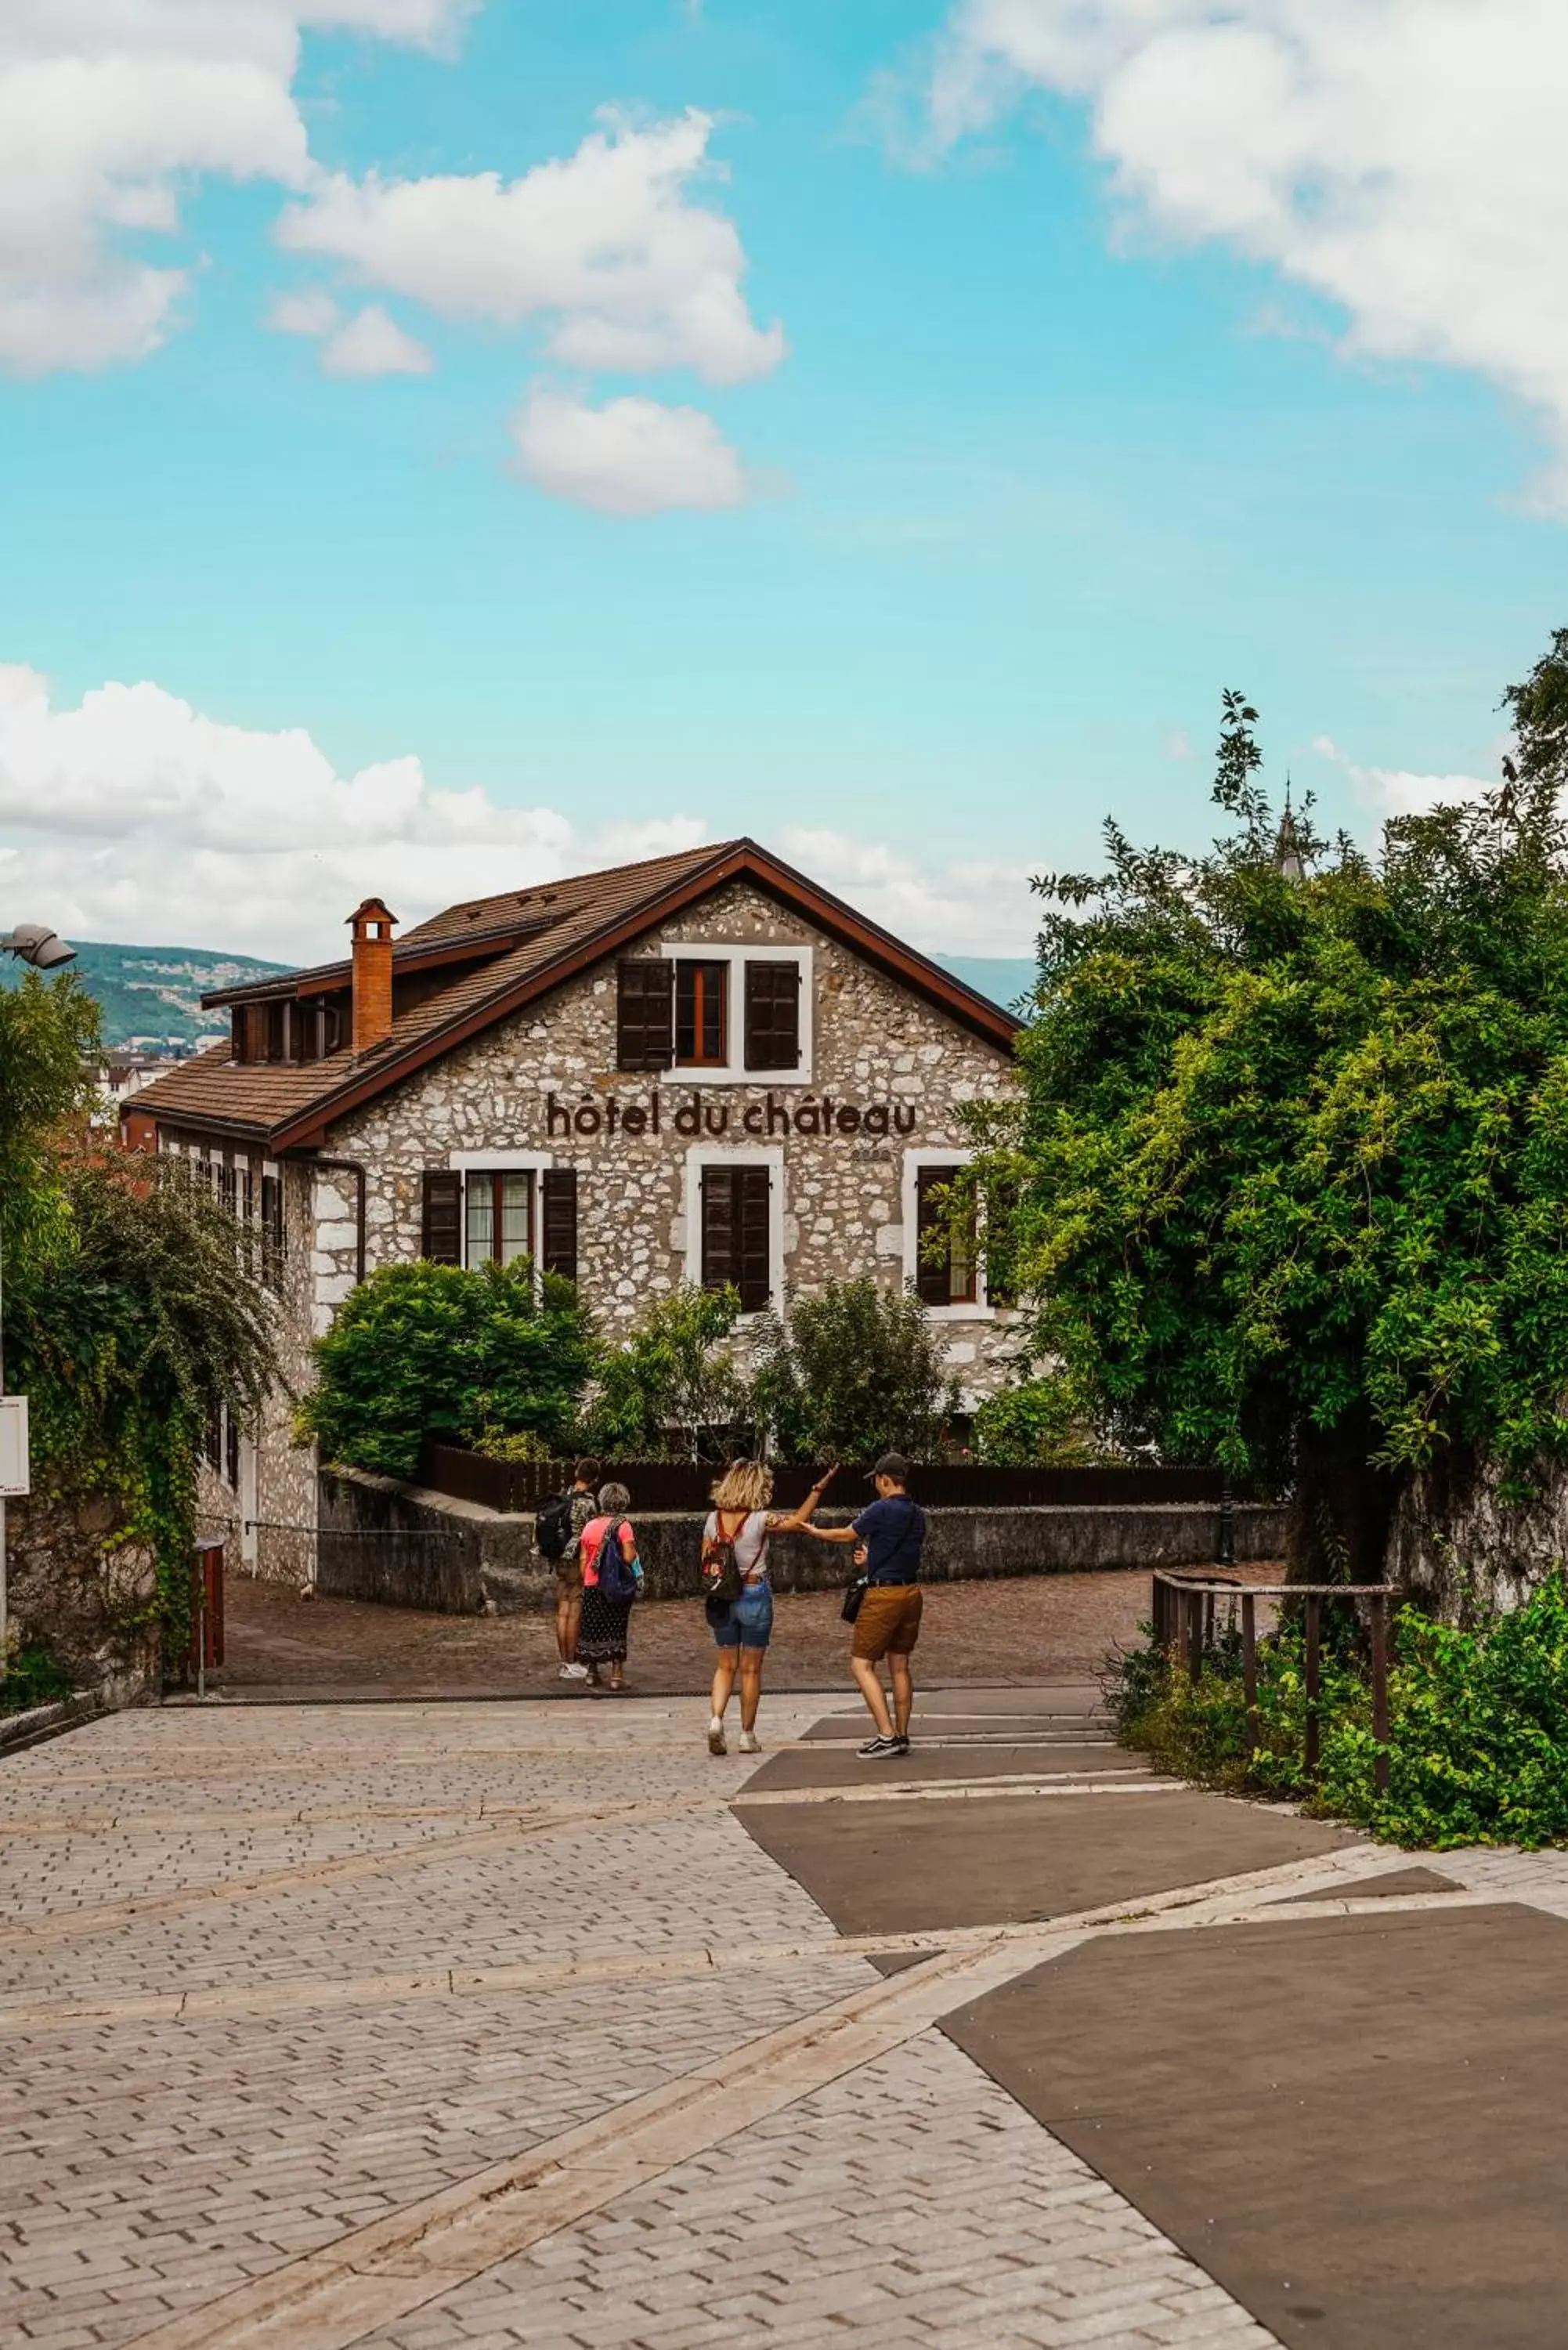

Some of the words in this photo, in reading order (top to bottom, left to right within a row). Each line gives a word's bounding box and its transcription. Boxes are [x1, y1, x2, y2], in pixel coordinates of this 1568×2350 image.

[548, 1091, 659, 1136] hôtel
[675, 1091, 728, 1136] du
[744, 1092, 916, 1136] château
